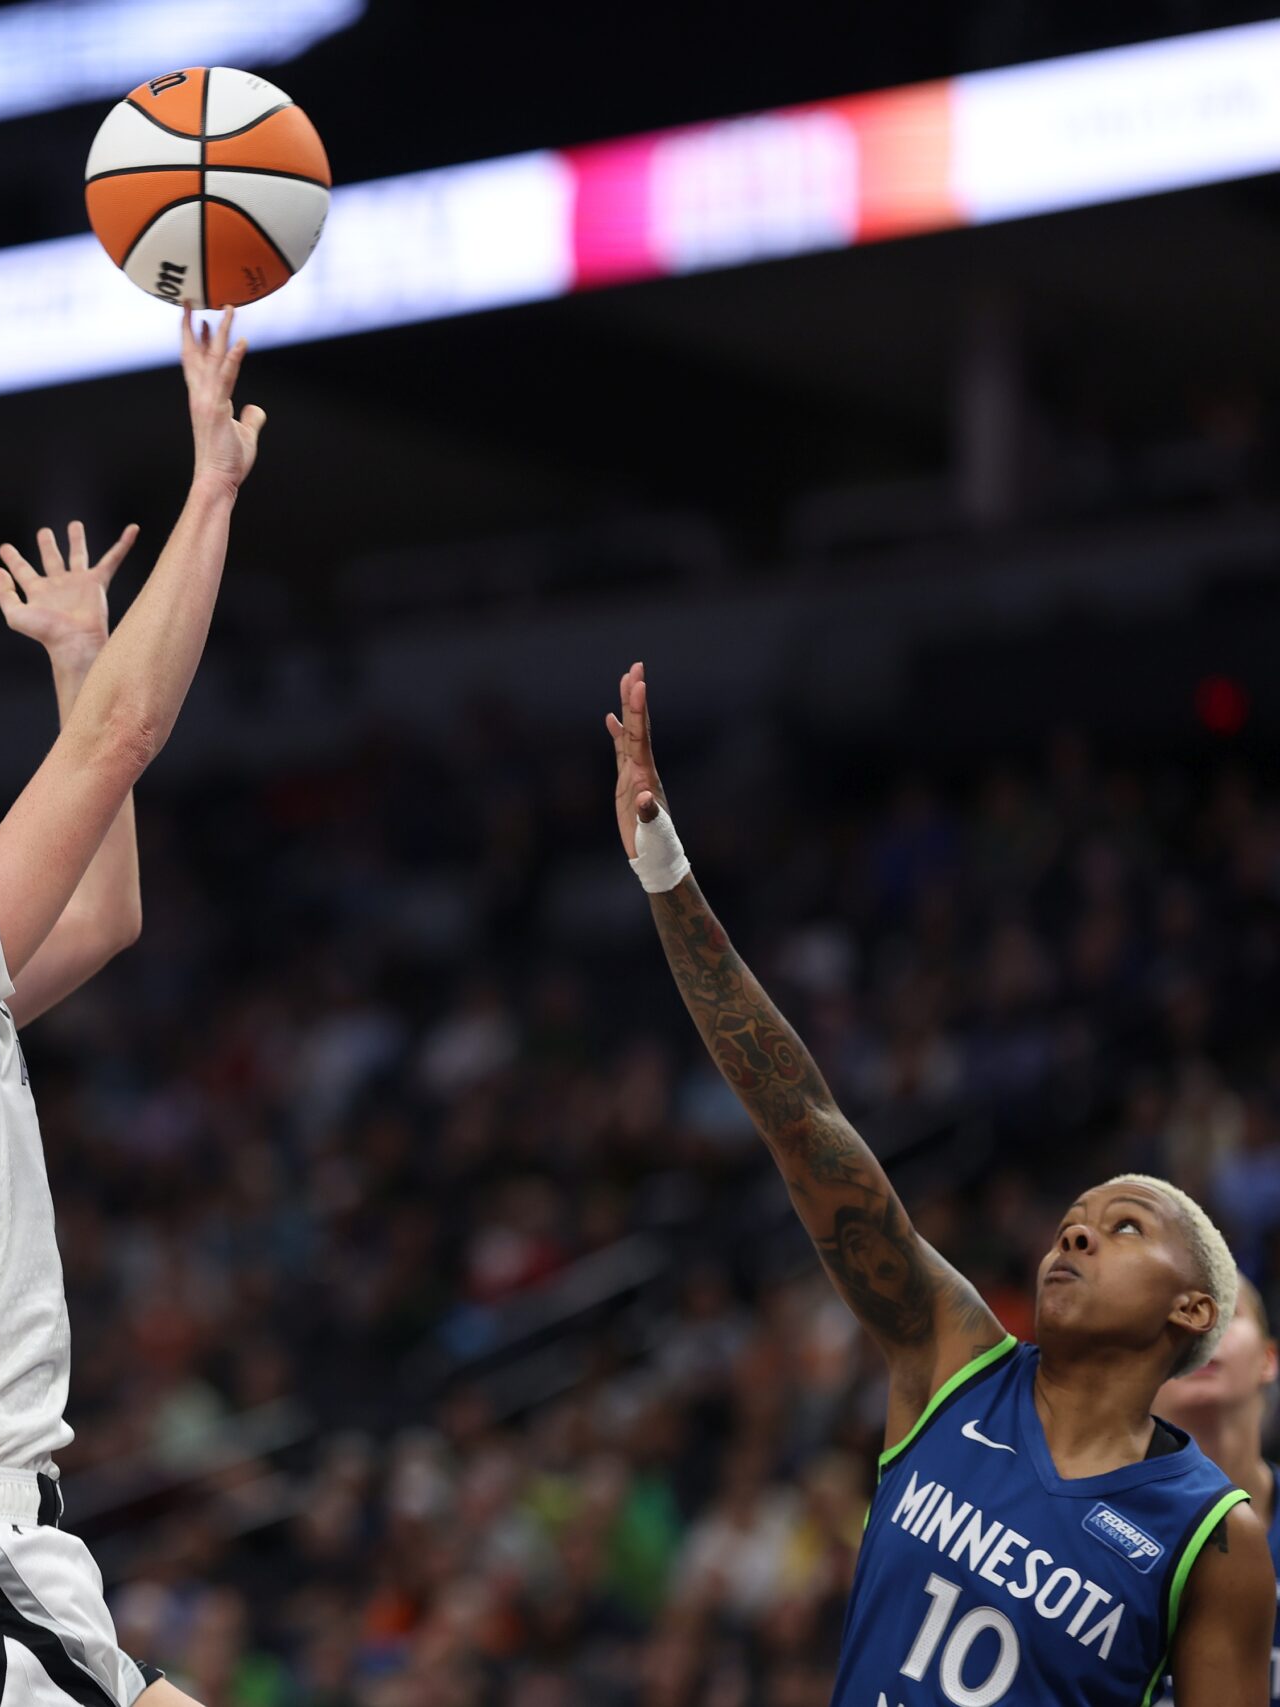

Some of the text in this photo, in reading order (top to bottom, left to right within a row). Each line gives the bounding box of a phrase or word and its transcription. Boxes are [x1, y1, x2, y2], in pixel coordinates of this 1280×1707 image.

[891, 1470, 1125, 1661] MINNESOTA
[1096, 1509, 1161, 1557] FEDERATED
[899, 1572, 1020, 1707] 10
